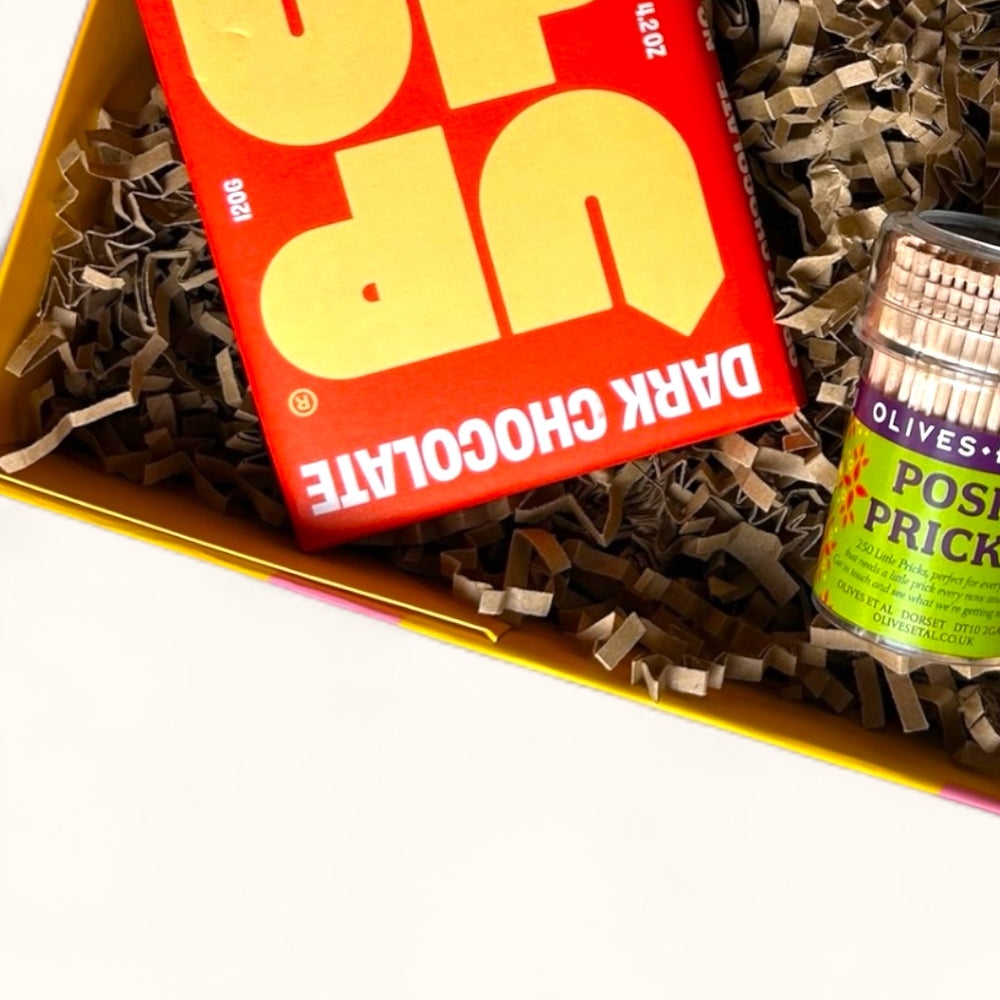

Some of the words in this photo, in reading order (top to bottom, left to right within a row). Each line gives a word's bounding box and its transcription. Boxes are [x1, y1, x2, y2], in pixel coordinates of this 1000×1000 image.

[610, 343, 763, 432] DARK
[300, 387, 609, 517] CHOCOLATE
[856, 539, 875, 556] 250
[874, 548, 896, 565] Little
[962, 576, 980, 589] for
[910, 580, 937, 594] prick
[837, 579, 865, 603] OLIVES
[865, 595, 881, 609] ET
[880, 604, 894, 615] AL
[901, 609, 948, 630] DORSET
[953, 621, 982, 634] DT10
[872, 581, 891, 594] and
[908, 594, 935, 608] what
